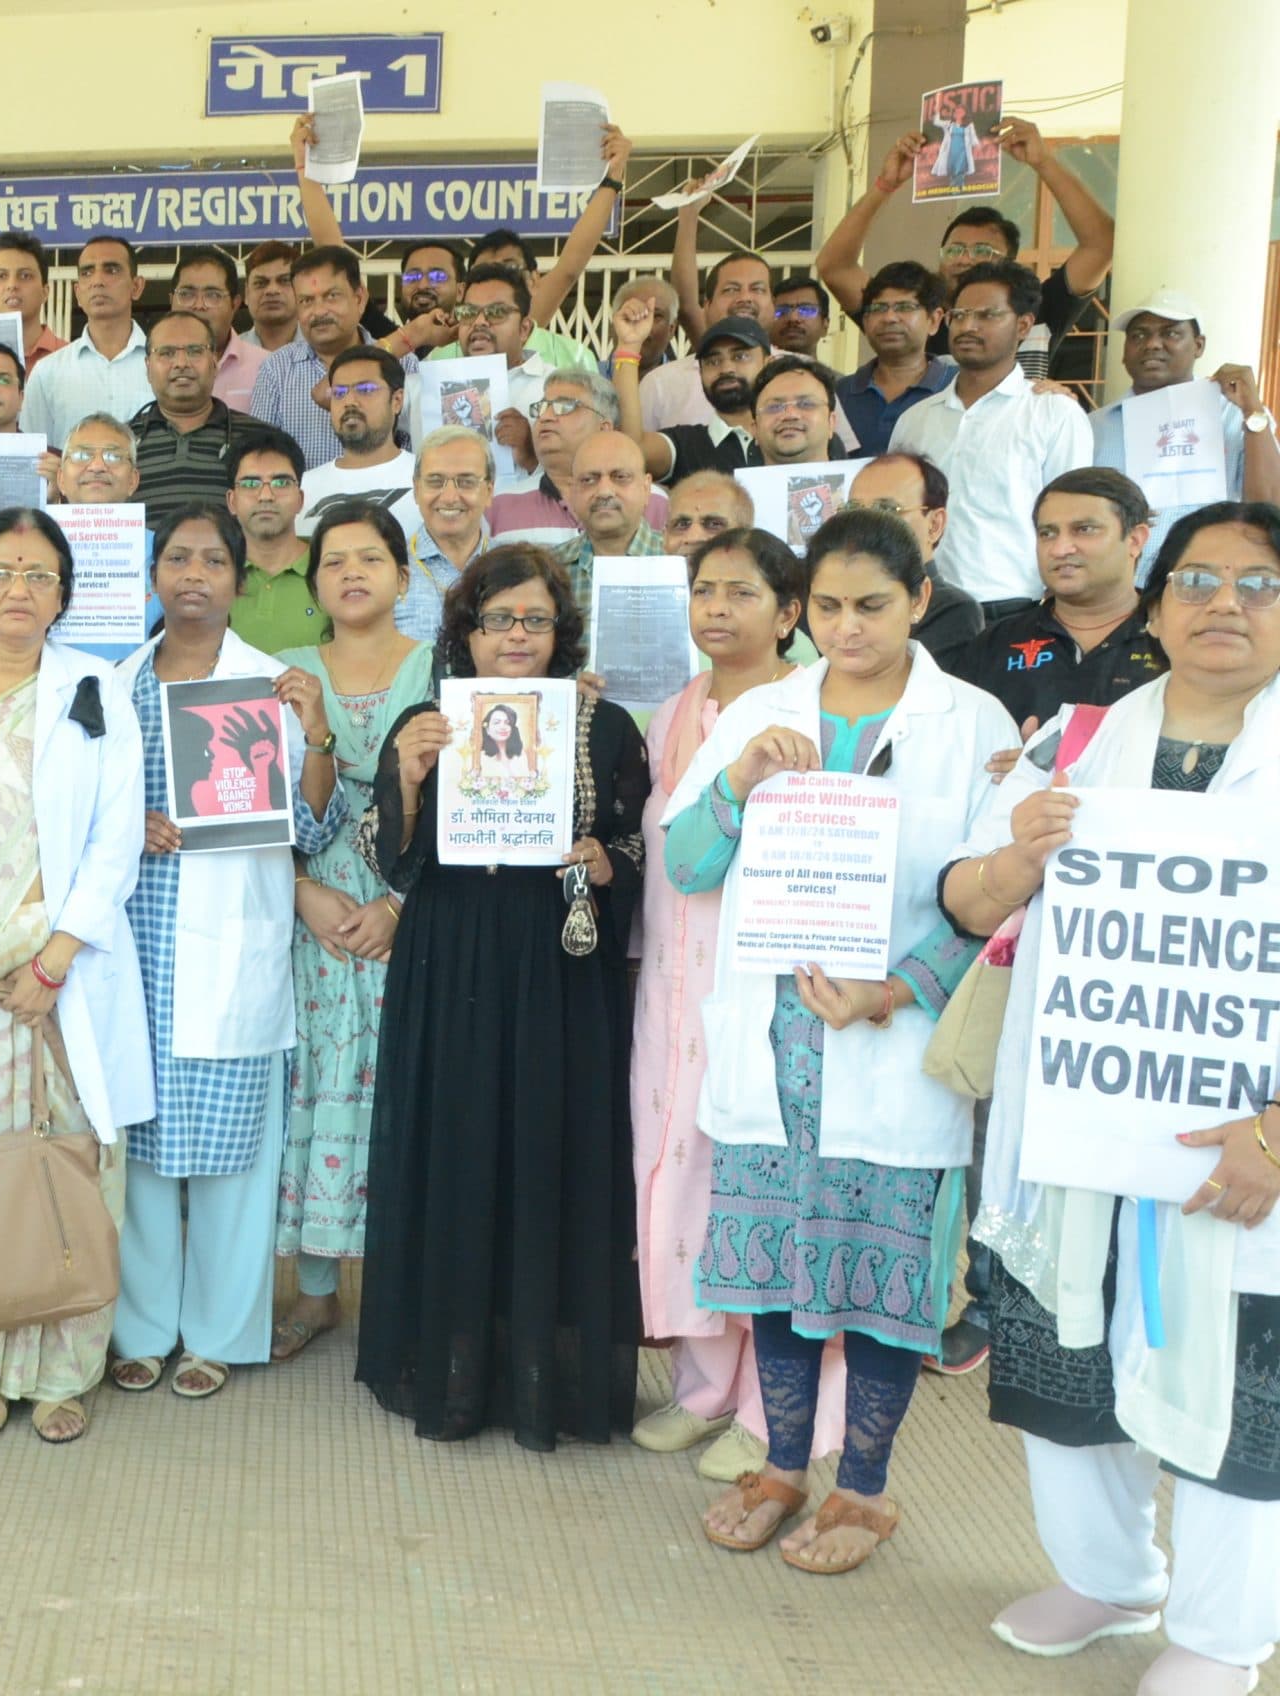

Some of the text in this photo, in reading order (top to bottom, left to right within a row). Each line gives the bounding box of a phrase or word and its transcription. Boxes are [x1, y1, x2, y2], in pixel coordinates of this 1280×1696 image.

[387, 54, 427, 96] 1
[1158, 444, 1195, 457] JUSTICE
[223, 767, 246, 779] STOP
[214, 777, 257, 790] VIOLENCE
[787, 776, 852, 788] IMA Calls for
[217, 789, 256, 802] AGAINST
[223, 800, 252, 812] WOMEN
[471, 808, 510, 824] मौमिता
[778, 811, 856, 826] of Services
[449, 829, 554, 847] भावभीनी श्रद्धांजलि
[743, 867, 887, 884] Closure of All non essential
[1055, 848, 1269, 897] STOP
[787, 884, 837, 895] services!
[811, 933, 837, 942] Private
[1052, 905, 1280, 974] VIOLENCE
[1043, 975, 1280, 1042] AGAINST
[1040, 1036, 1271, 1113] WOMEN
